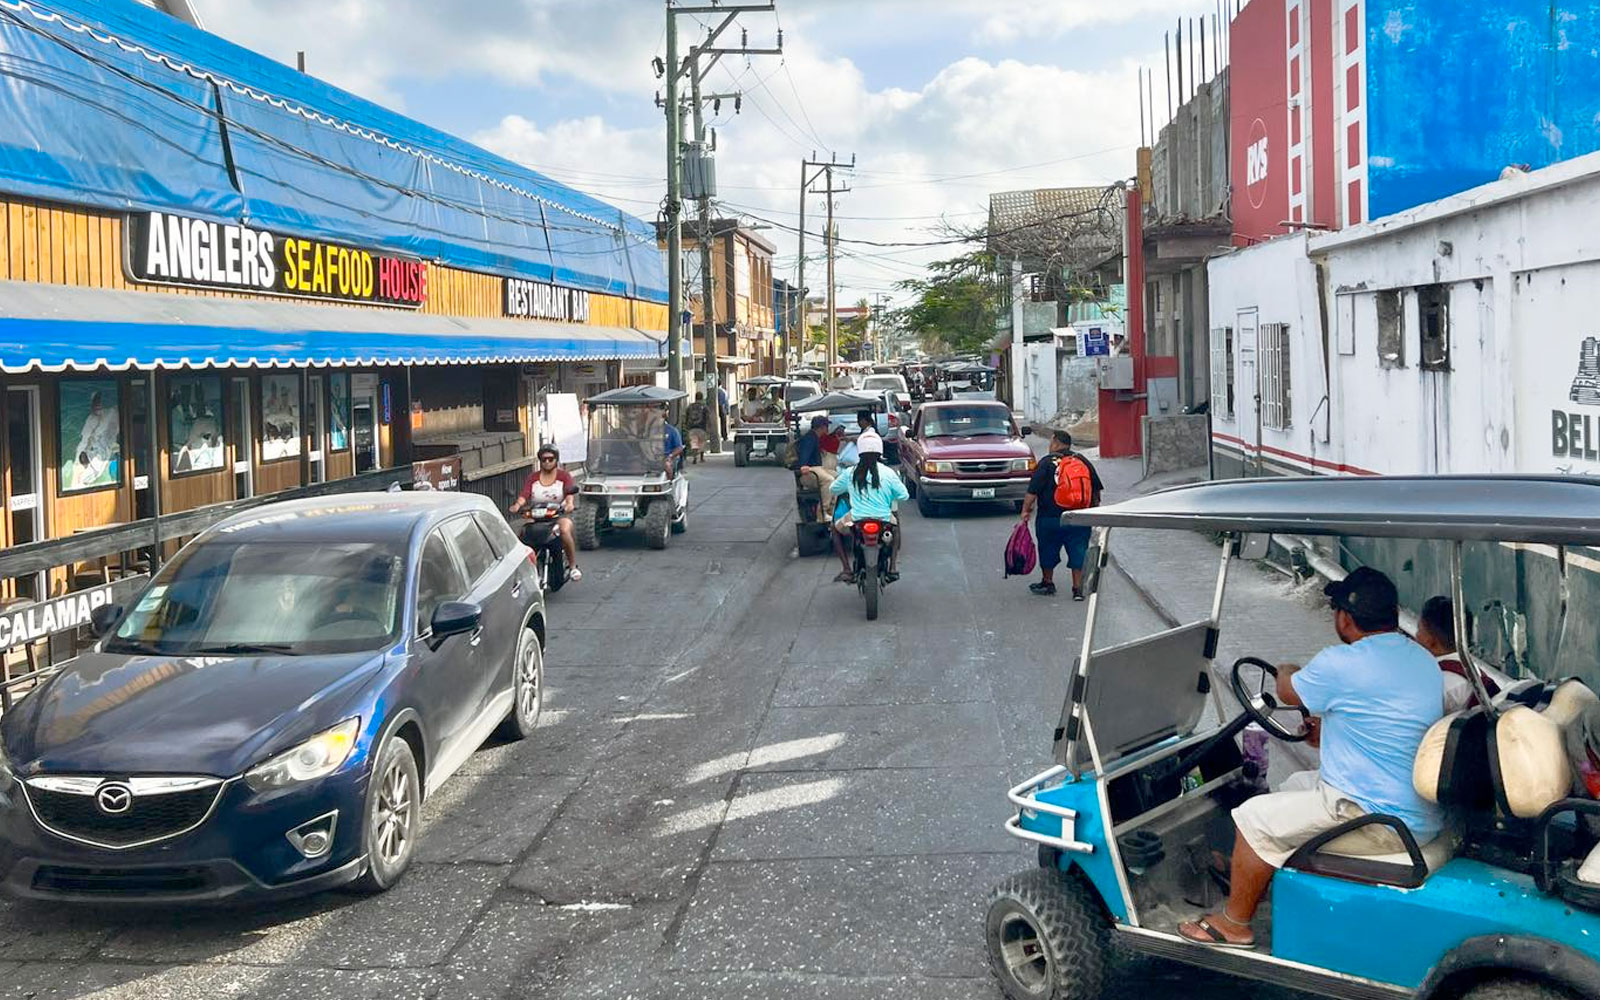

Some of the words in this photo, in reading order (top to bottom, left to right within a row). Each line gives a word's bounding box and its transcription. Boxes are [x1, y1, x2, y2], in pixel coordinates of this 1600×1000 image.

[146, 211, 275, 289] ANGLERS
[284, 237, 373, 298] SEAFOOD
[379, 255, 427, 302] HOUSE
[508, 277, 570, 320] RESTAURANT
[572, 288, 589, 322] BAR
[1552, 409, 1600, 462] BEL
